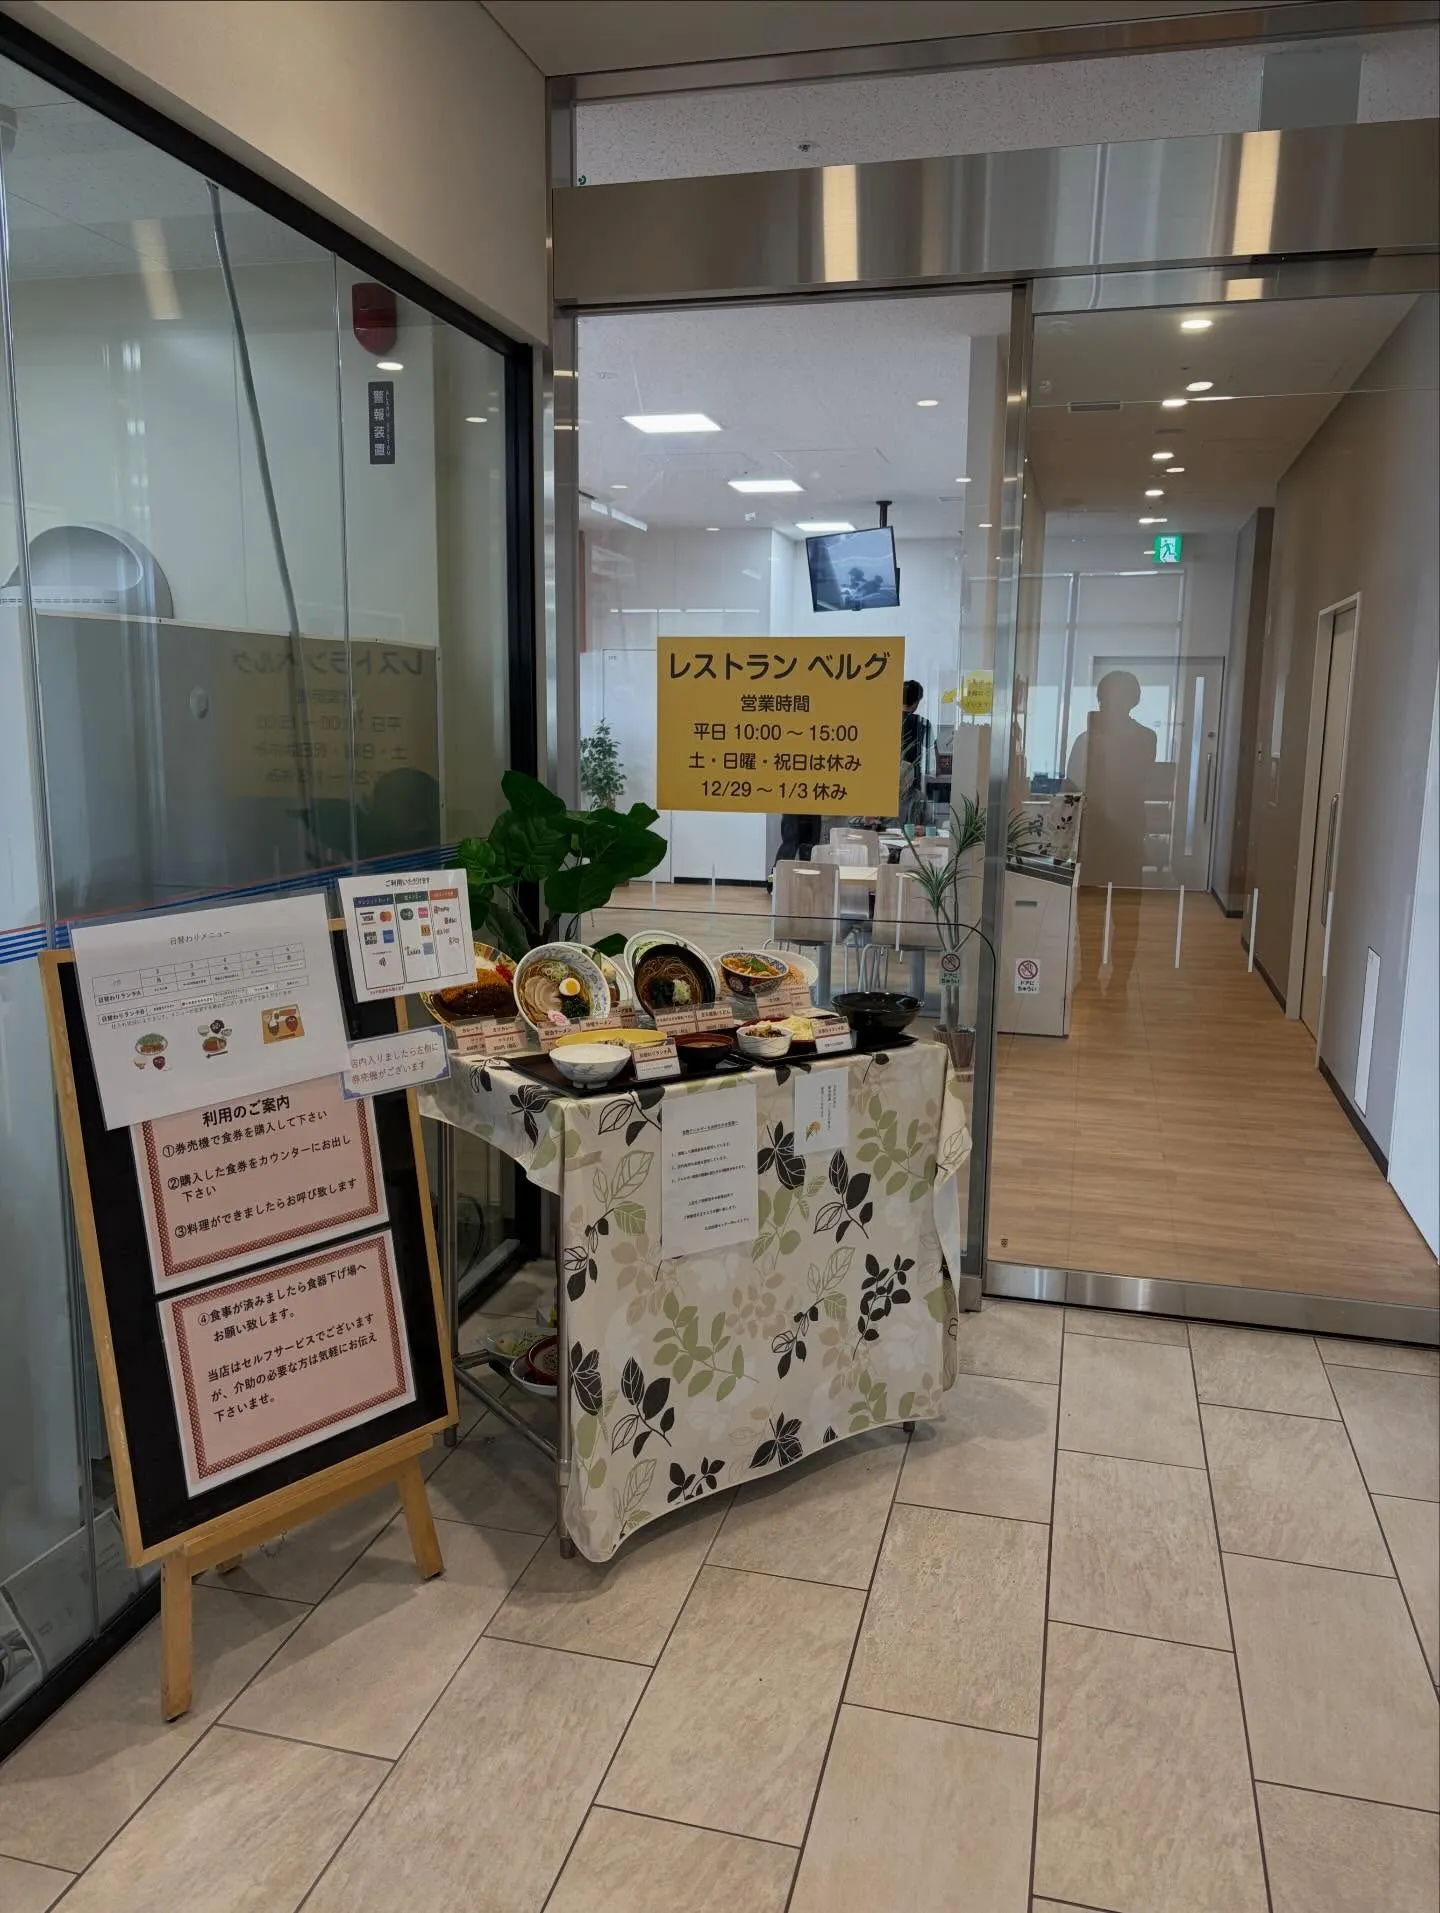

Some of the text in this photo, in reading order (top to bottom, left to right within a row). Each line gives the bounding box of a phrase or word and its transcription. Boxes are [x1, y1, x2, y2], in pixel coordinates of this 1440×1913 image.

[669, 651, 891, 681] レストラン ベルグ
[740, 694, 811, 713] 営業時間
[693, 722, 726, 741] 平日
[734, 724, 782, 741] 10:00
[809, 725, 859, 742] 15:00
[687, 751, 862, 772] 土・日曜・祝日は休み
[701, 780, 752, 798] 12/29
[778, 782, 808, 800] 1/3
[812, 782, 848, 801] 休み
[169, 930, 232, 946] 日替わりメニュー
[202, 1094, 291, 1128] 利用のご案内
[181, 1185, 217, 1203] 下さい
[213, 1307, 296, 1343] お願い致します。
[207, 1312, 375, 1383] 当店はセルフサービスでございます
[210, 1331, 378, 1403] が、介助の必要な方は気軽にお伝え
[213, 1392, 276, 1422] 下さいませ。
